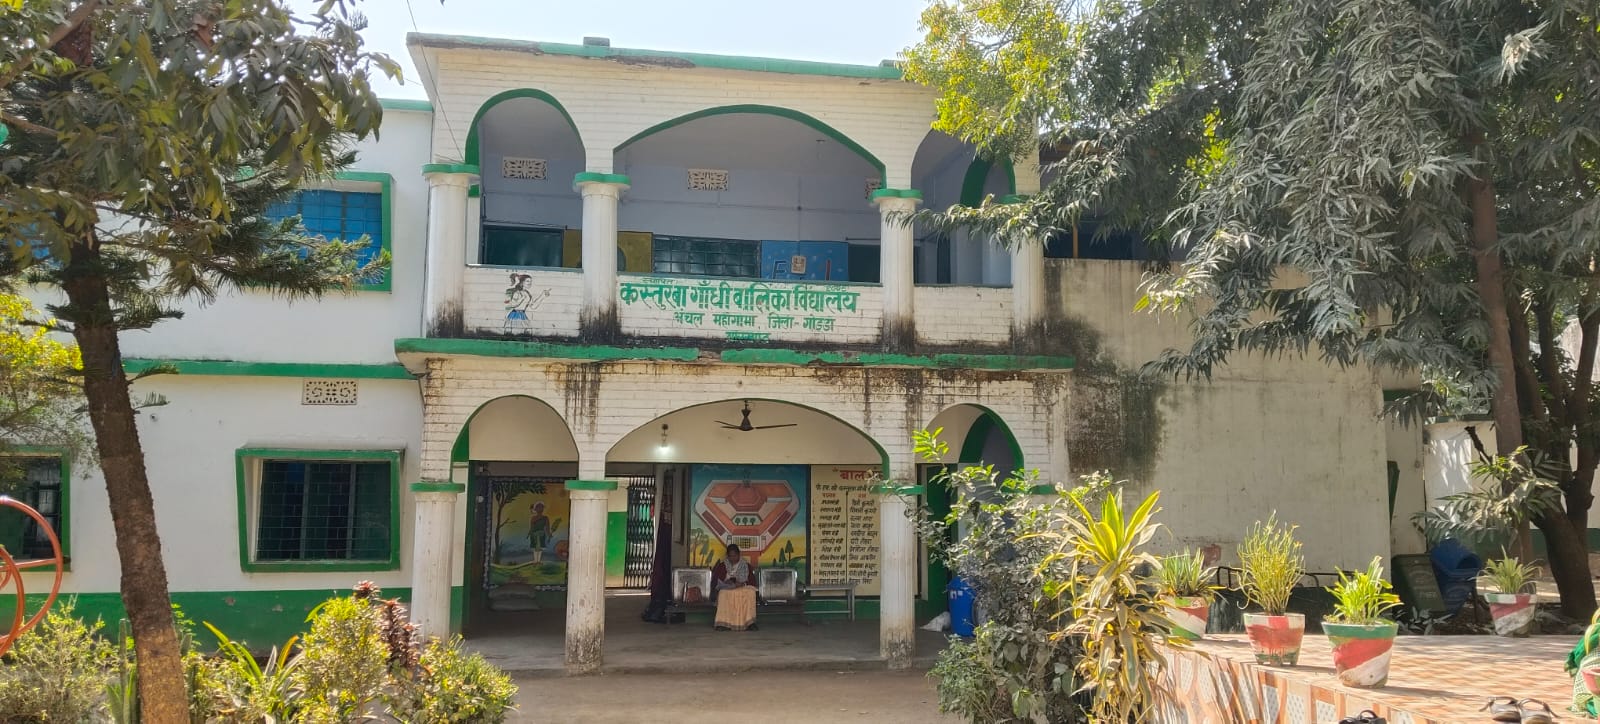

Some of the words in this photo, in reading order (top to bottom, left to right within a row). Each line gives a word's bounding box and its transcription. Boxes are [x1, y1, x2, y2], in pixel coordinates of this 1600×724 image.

[690, 279, 733, 309] गाँधी
[733, 282, 792, 313] बालिका
[792, 285, 861, 314] विद्यालय
